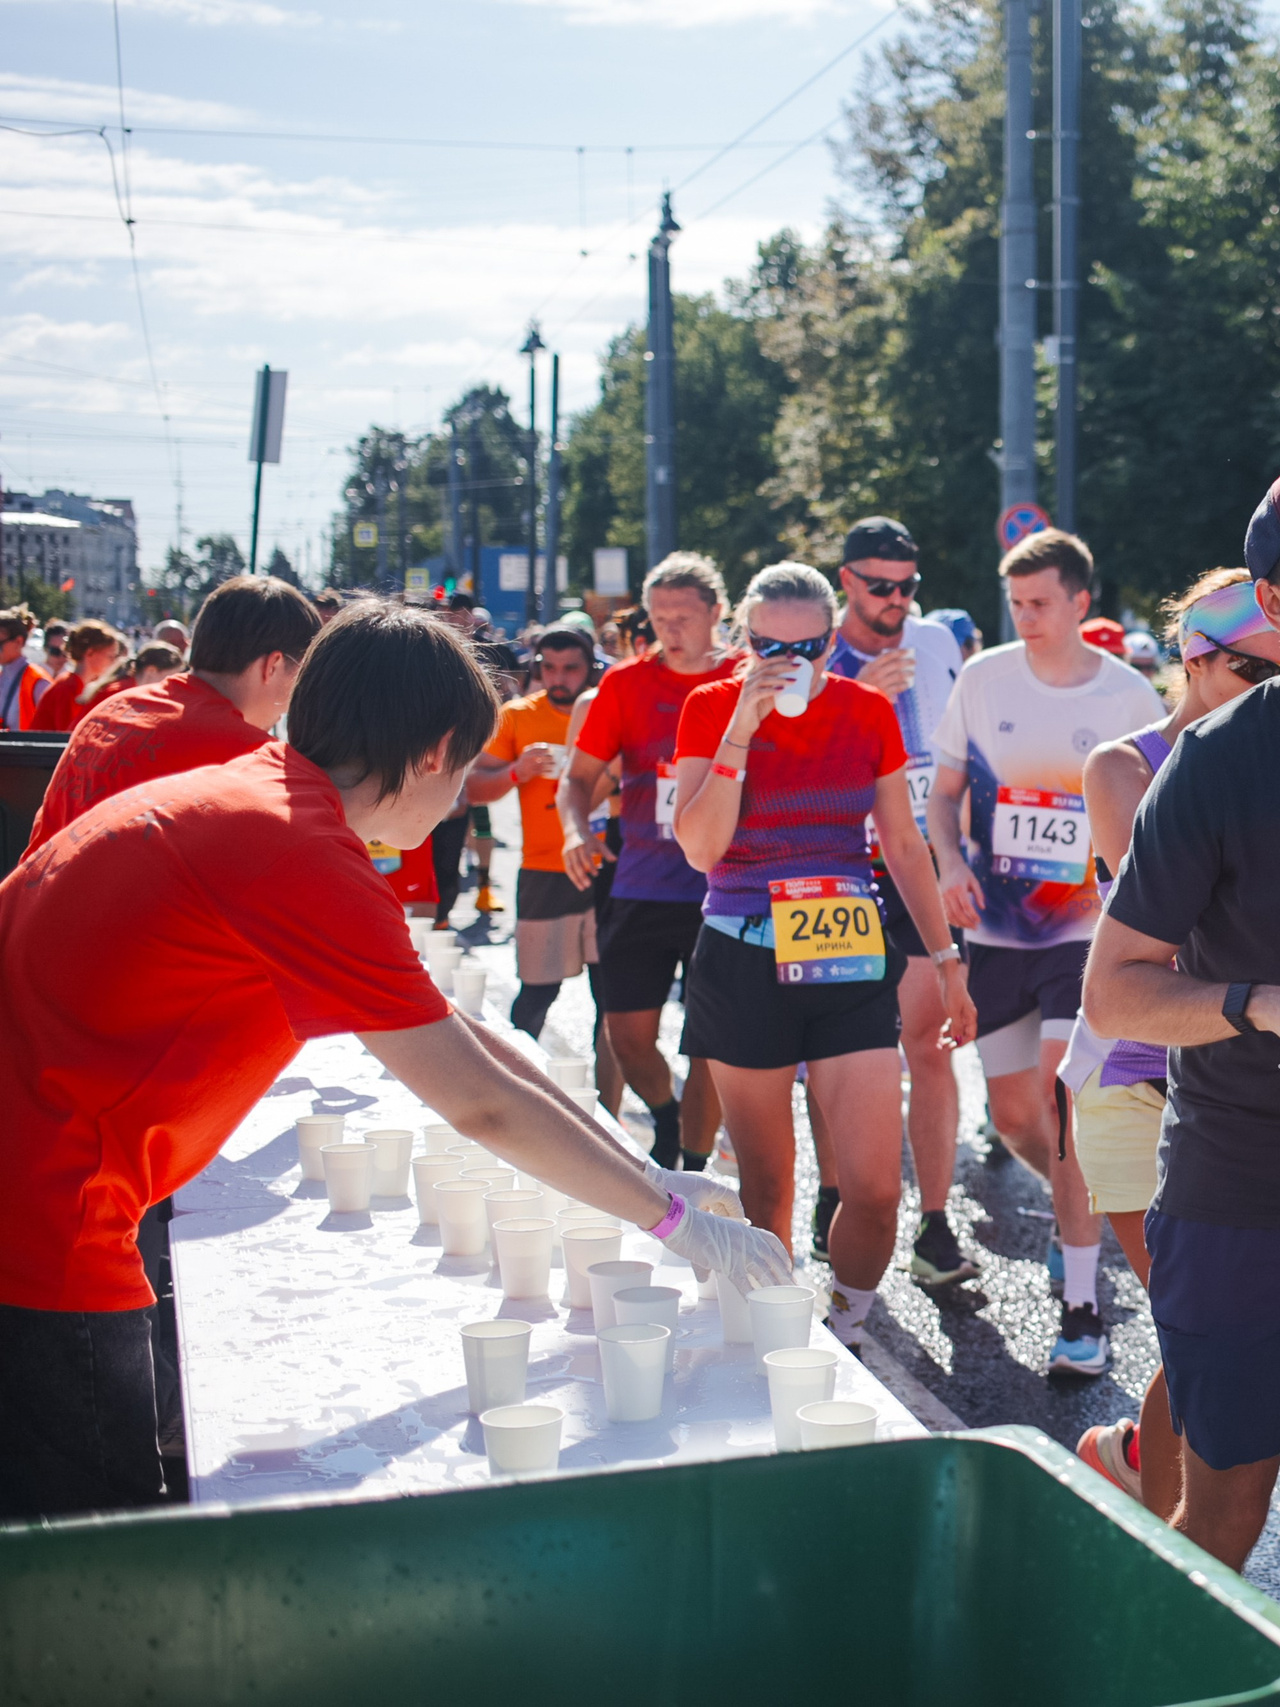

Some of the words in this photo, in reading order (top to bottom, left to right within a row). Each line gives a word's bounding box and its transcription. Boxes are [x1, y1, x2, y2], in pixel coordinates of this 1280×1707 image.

[1009, 813, 1078, 846] 1143
[999, 857, 1011, 873] D
[790, 906, 870, 942] 2490
[816, 942, 853, 952] ИРИНА
[788, 963, 803, 982] D
